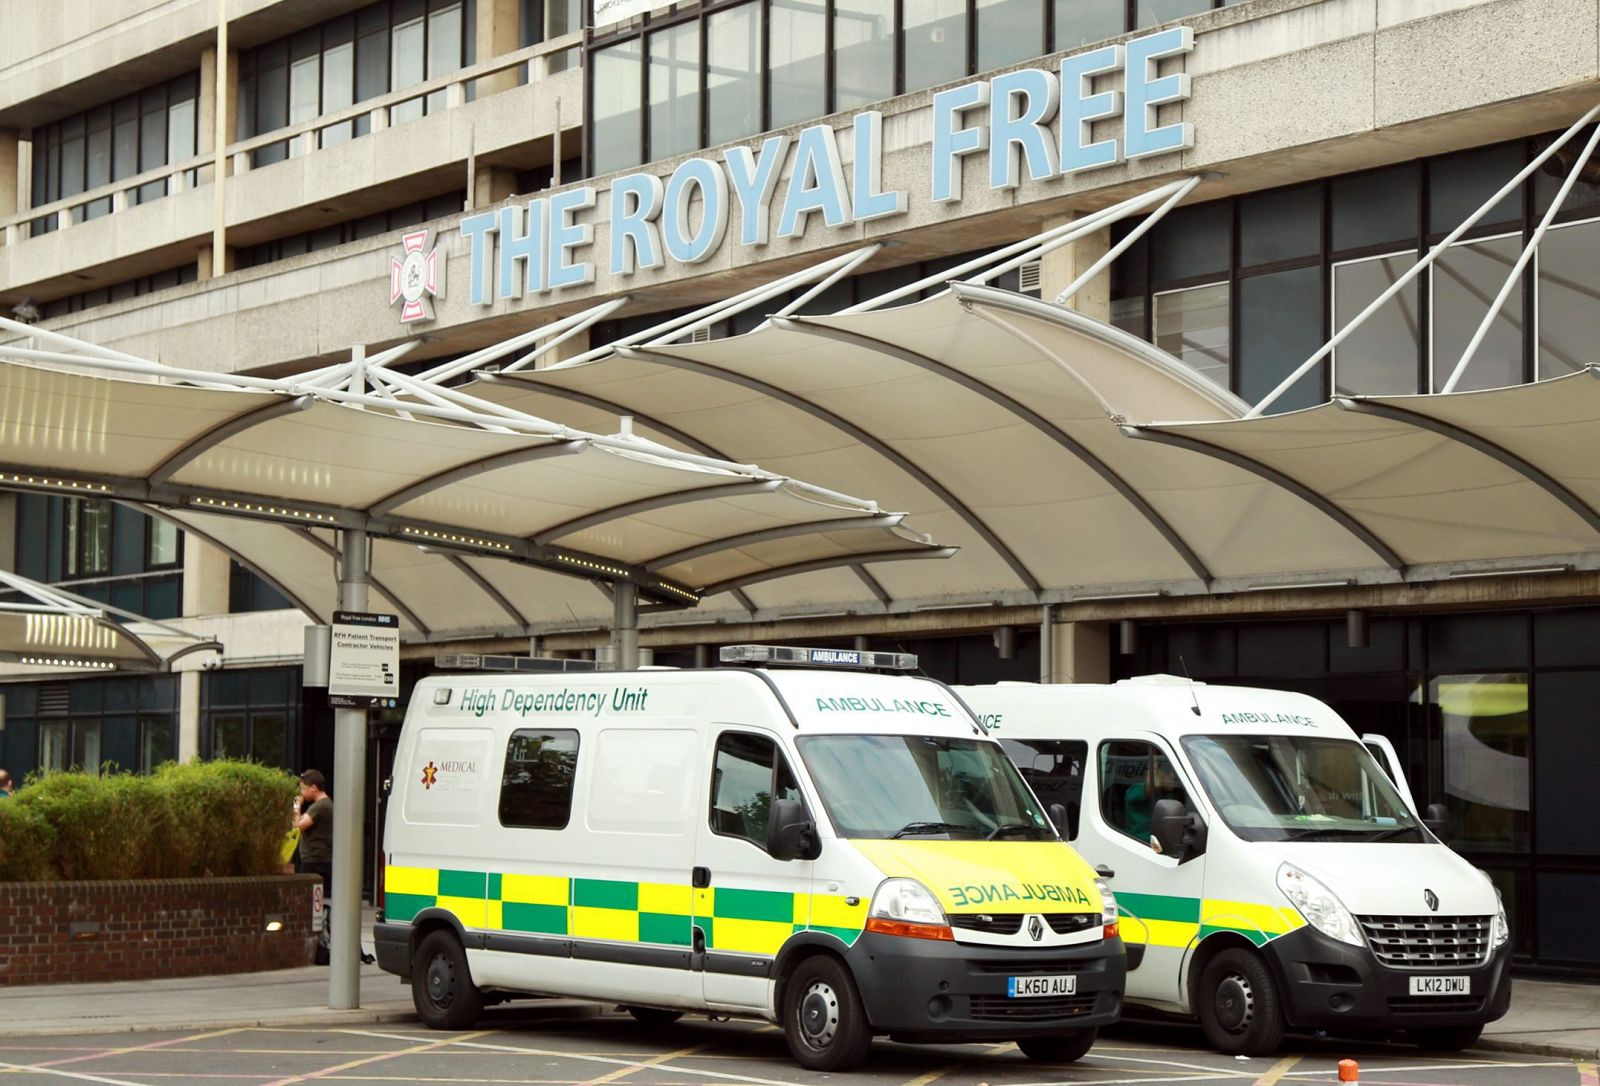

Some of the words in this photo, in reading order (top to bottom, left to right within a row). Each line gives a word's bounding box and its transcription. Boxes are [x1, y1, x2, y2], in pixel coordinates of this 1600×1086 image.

[460, 186, 596, 307] THE
[610, 110, 908, 276] ROYAL
[931, 26, 1195, 207] FREE
[378, 615, 391, 623] NHS
[336, 641, 368, 650] Contractor
[347, 633, 368, 641] Patient
[369, 634, 397, 643] Transport
[812, 651, 858, 664] AMBULANCE
[460, 688, 497, 717] High
[501, 688, 607, 718] Dependency
[612, 687, 649, 711] Unit
[815, 697, 952, 718] AMBULANCE
[978, 713, 1003, 730] NCE
[1221, 712, 1319, 728] AMBULANCE
[440, 760, 477, 773] MEDICAL
[1016, 978, 1048, 995] LK60
[1052, 978, 1075, 994] AUJ
[1416, 978, 1442, 992] LK12
[1445, 978, 1465, 992] DWU
